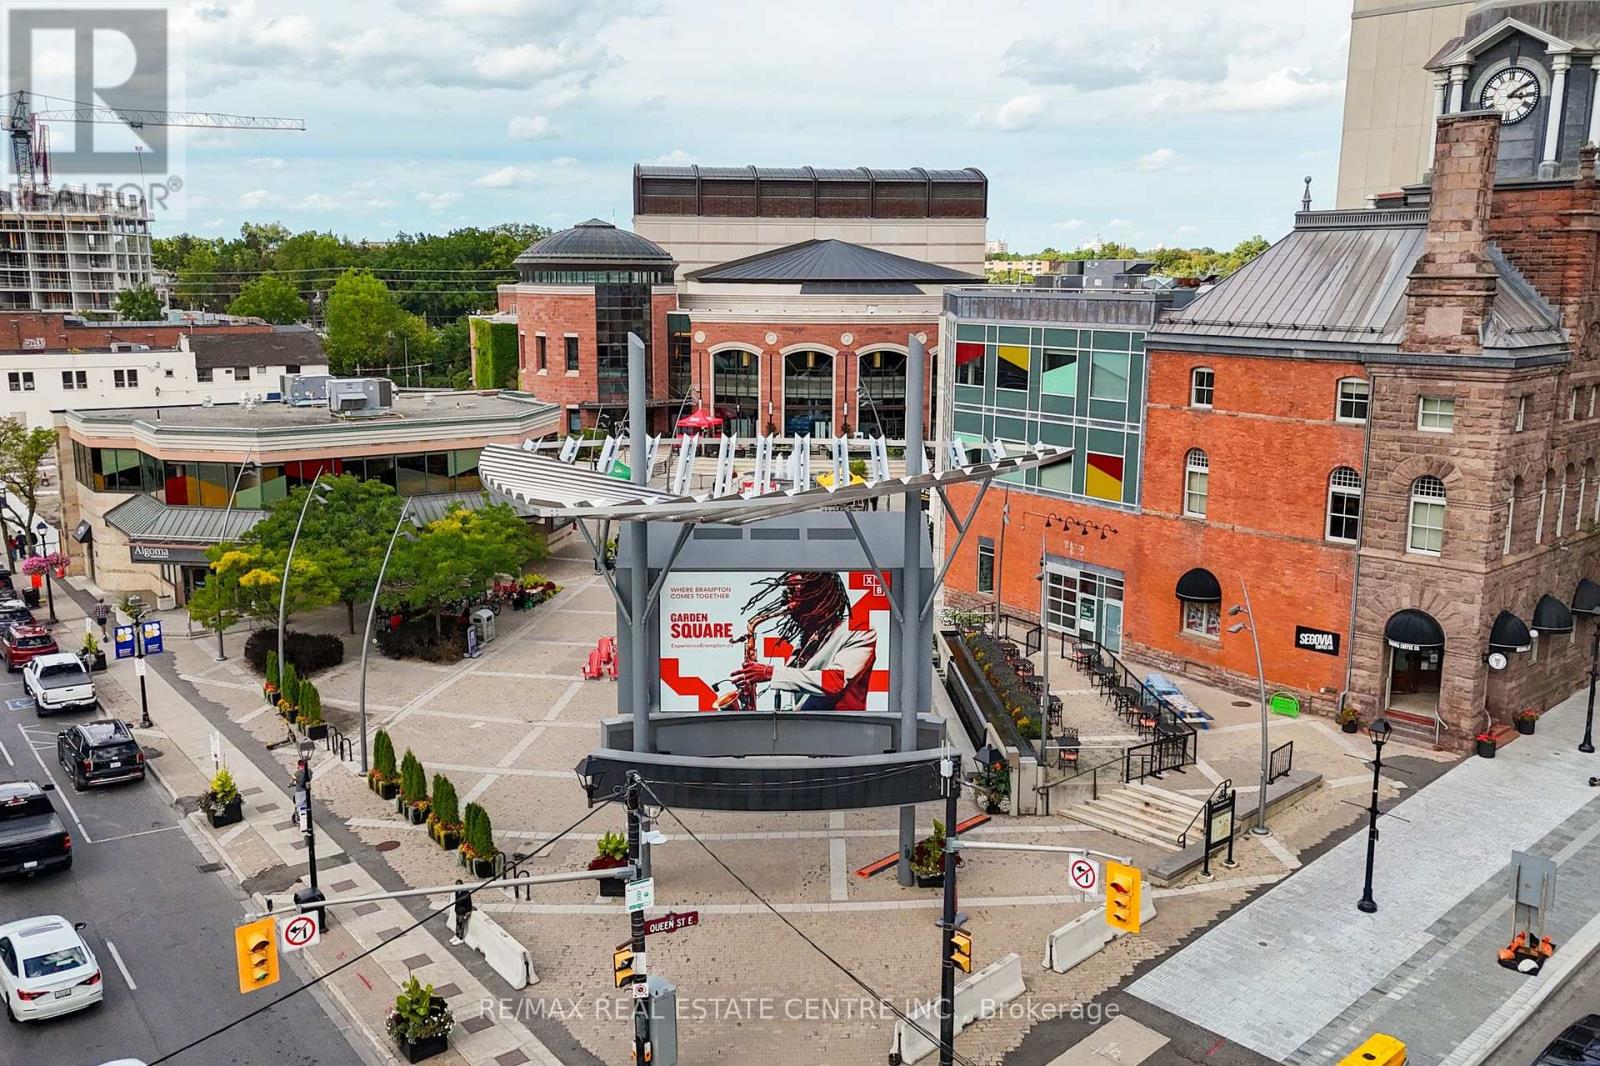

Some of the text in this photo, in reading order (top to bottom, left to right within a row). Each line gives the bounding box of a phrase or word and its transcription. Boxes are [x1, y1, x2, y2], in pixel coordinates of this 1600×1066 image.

[135, 547, 169, 558] Algoma
[671, 613, 708, 622] GARDEN
[671, 623, 733, 638] SQUARE
[1299, 633, 1333, 646] SEGOVIA
[650, 916, 693, 933] QUEEN ST E
